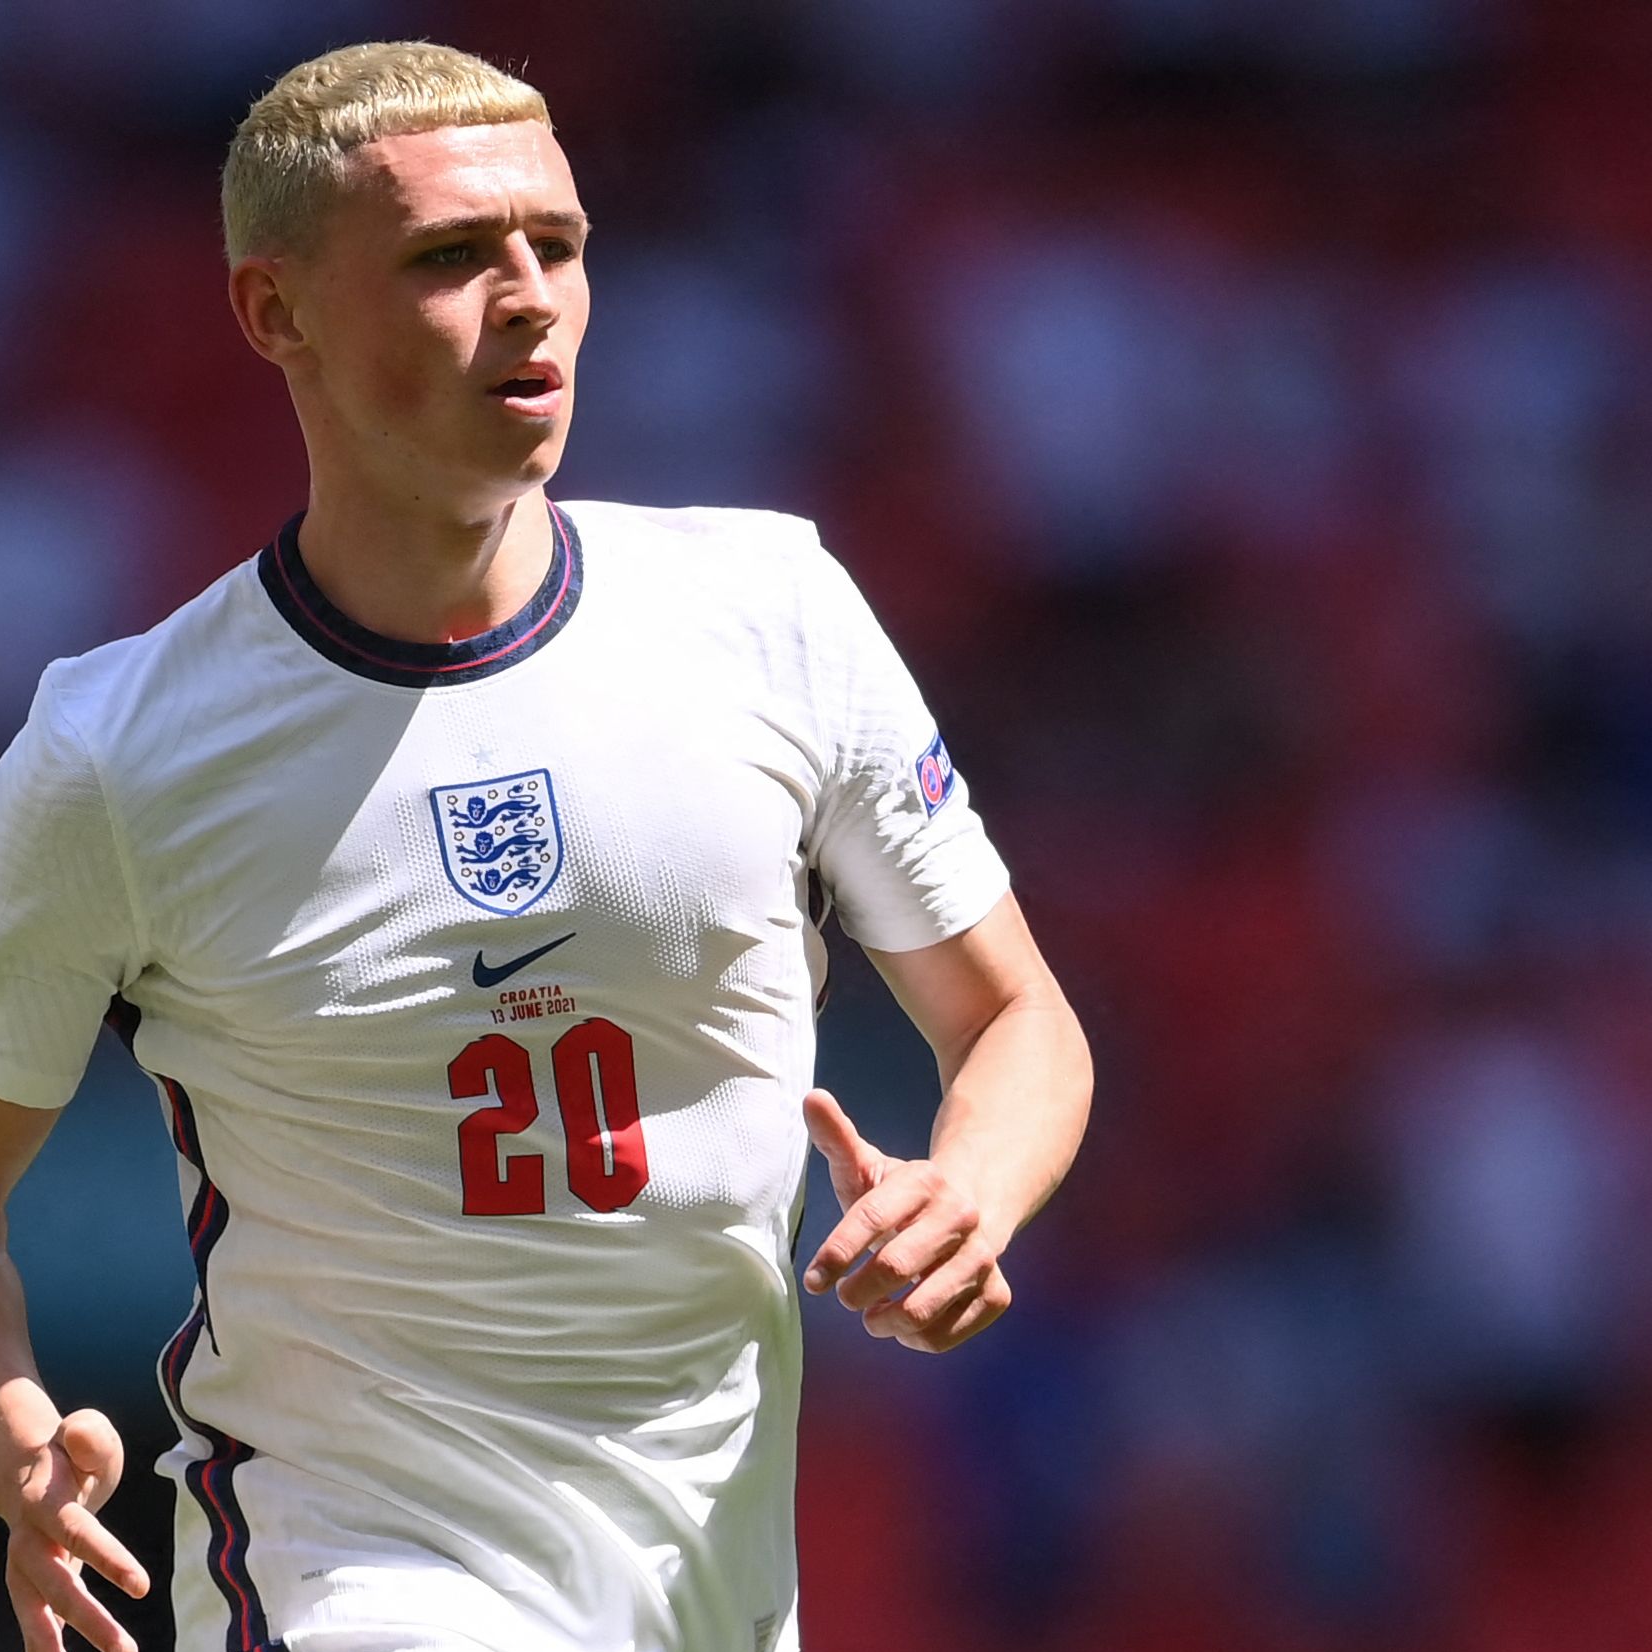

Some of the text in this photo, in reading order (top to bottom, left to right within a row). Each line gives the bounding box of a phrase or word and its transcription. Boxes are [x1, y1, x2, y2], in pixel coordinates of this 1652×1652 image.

[499, 985, 562, 1005] CROATIA
[490, 997, 576, 1024] 13 JUNE 2021
[447, 1017, 649, 1216] 20
